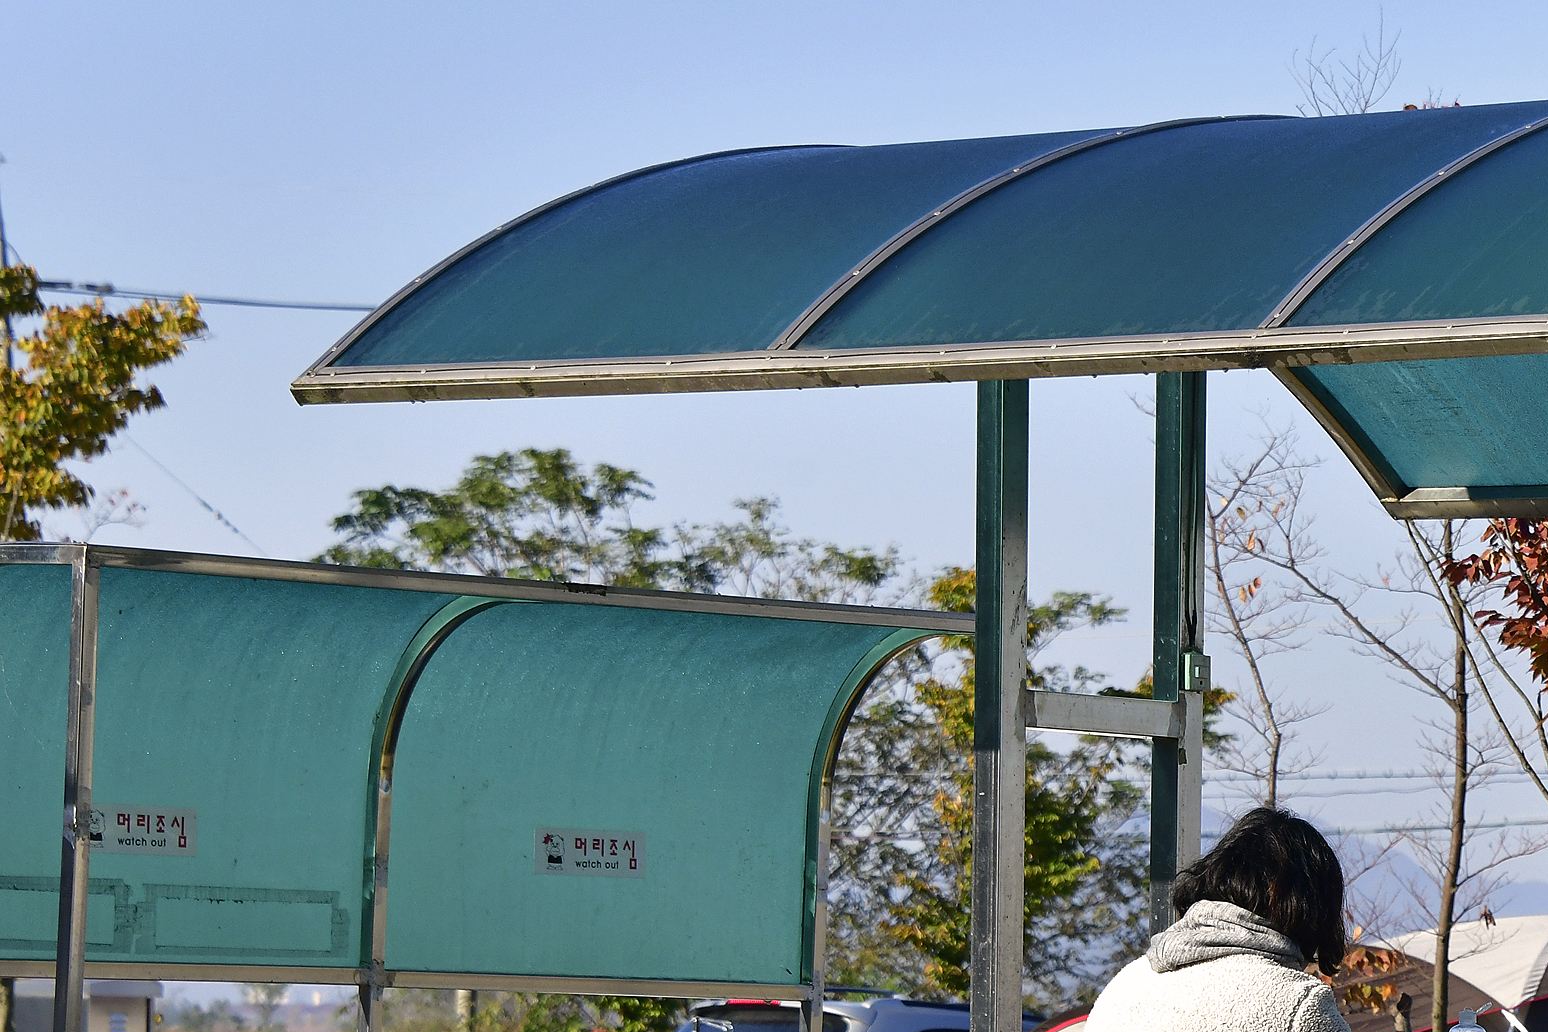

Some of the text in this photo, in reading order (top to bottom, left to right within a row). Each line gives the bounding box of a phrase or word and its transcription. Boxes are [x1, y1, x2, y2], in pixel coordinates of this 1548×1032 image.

[117, 813, 187, 848] 머리조심
[117, 837, 167, 847] watch out
[574, 837, 637, 870] 머리조심
[575, 860, 619, 869] watch out
